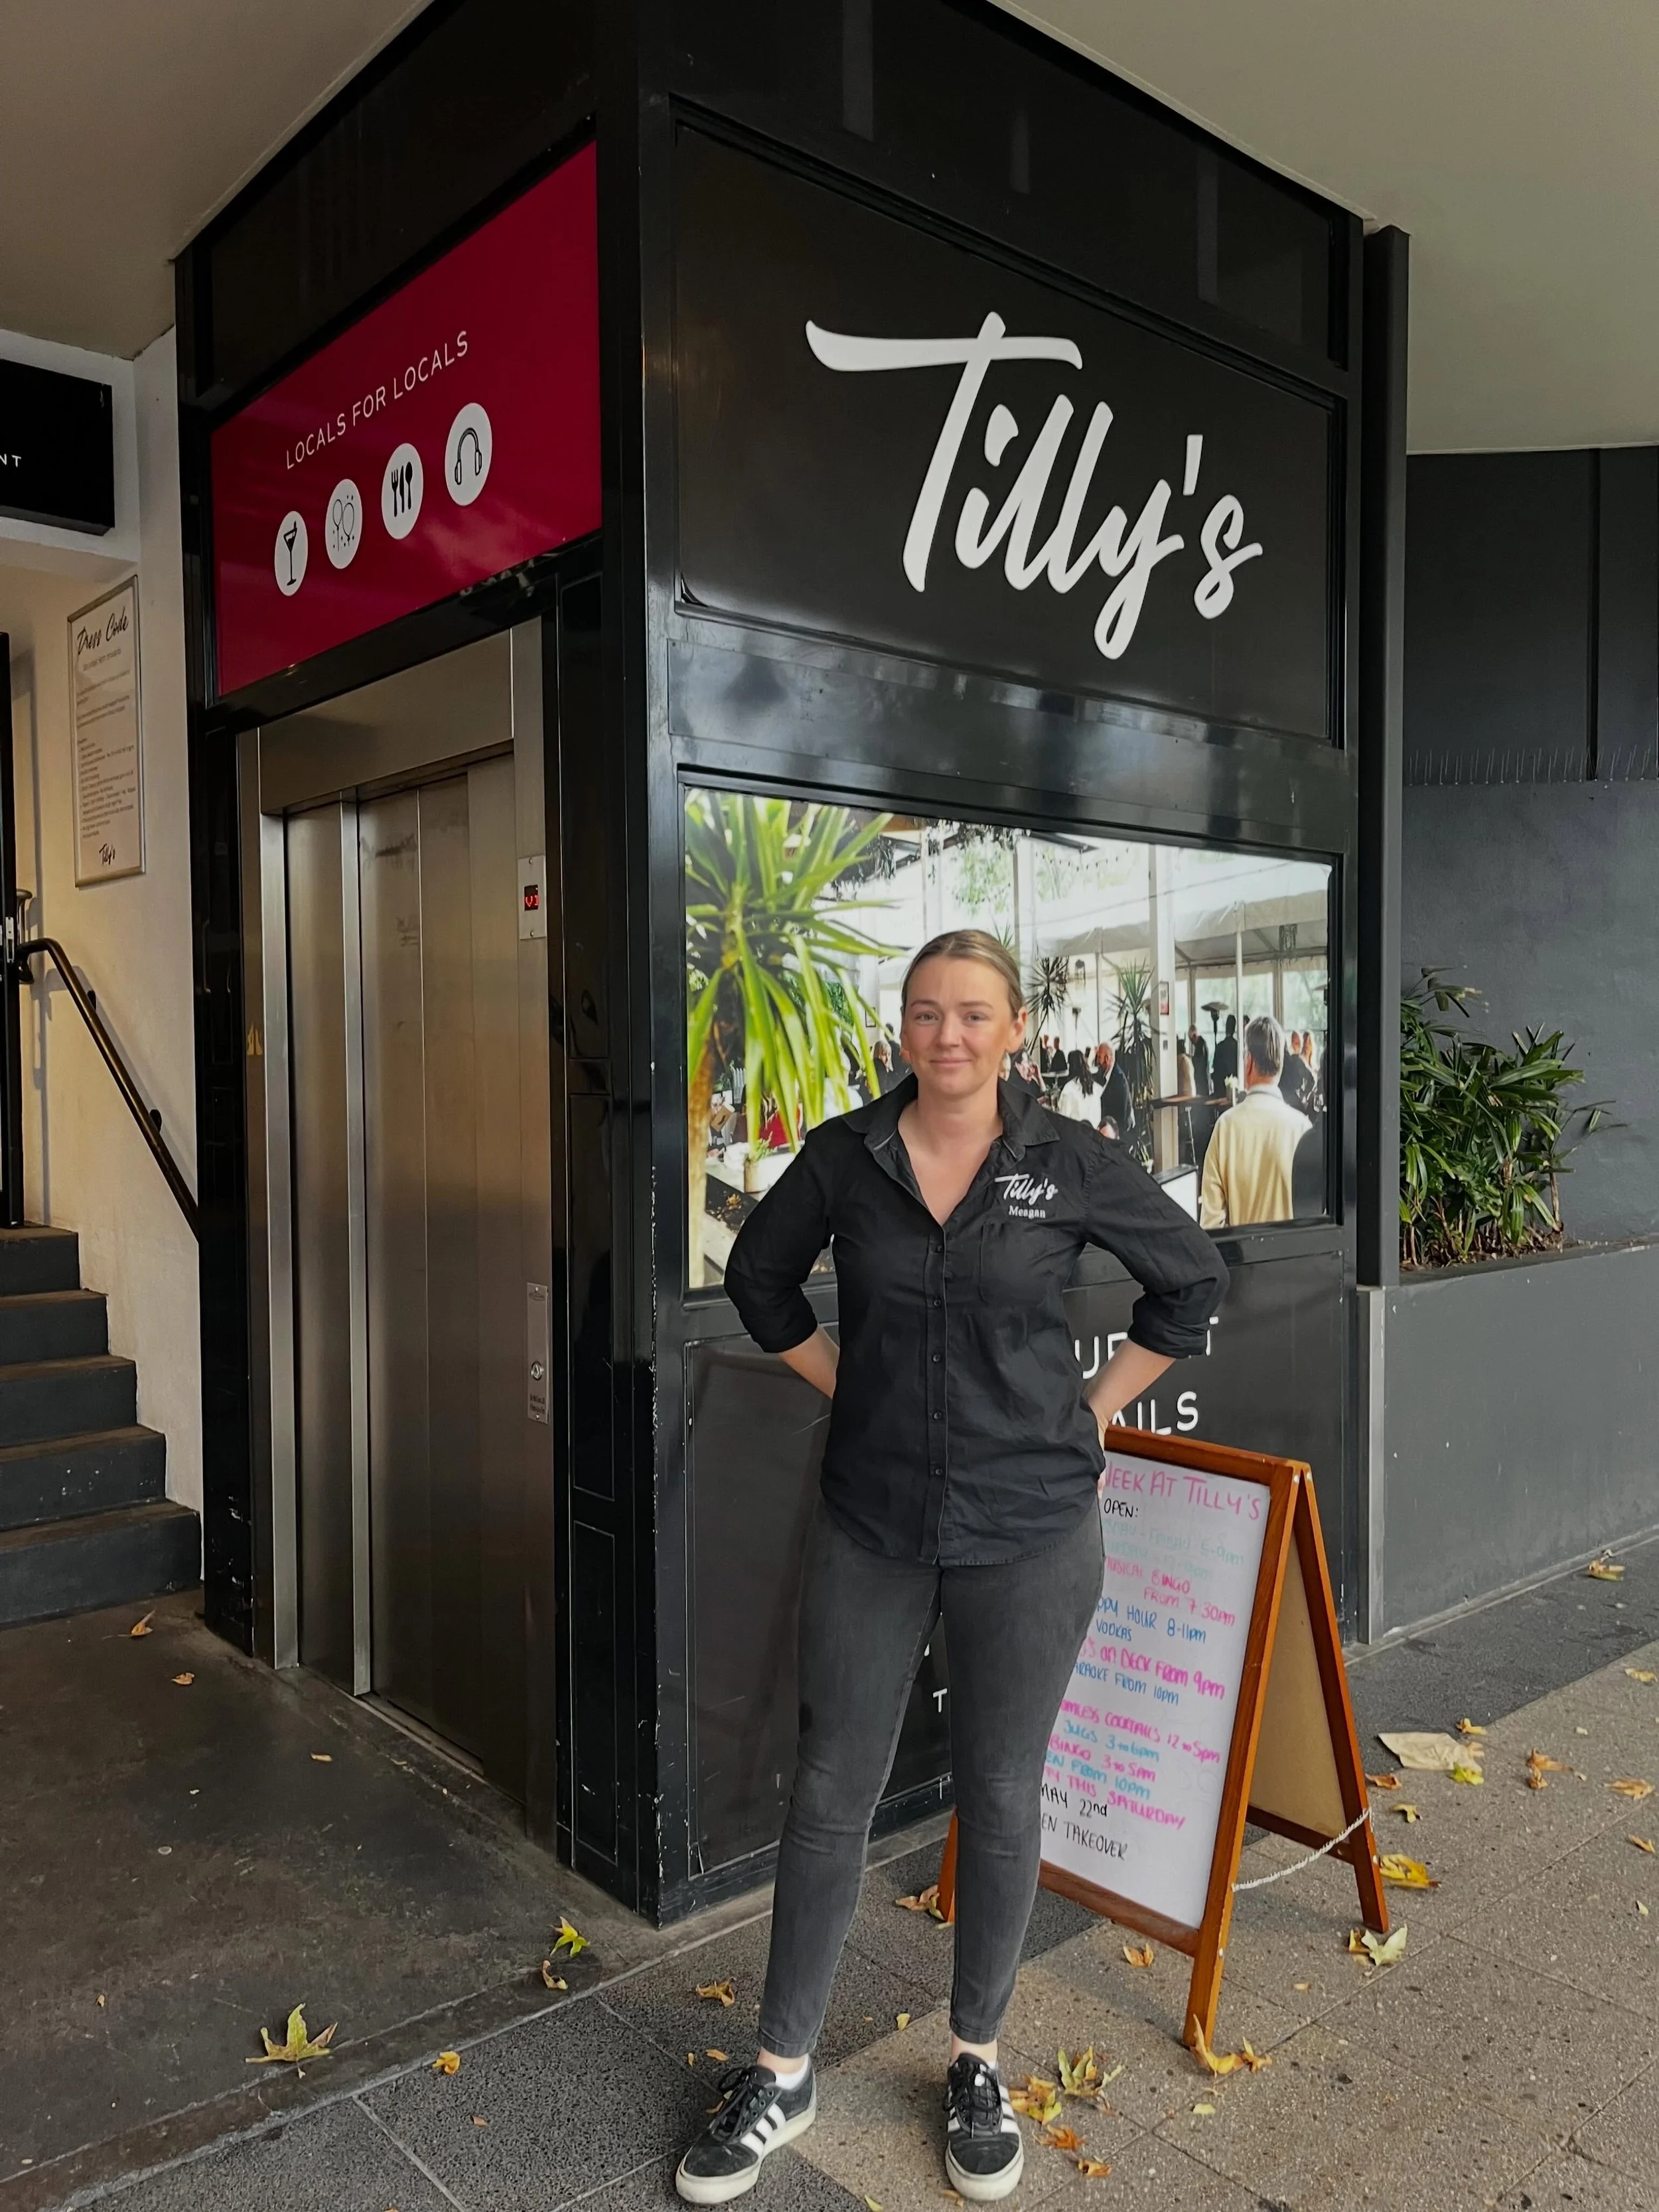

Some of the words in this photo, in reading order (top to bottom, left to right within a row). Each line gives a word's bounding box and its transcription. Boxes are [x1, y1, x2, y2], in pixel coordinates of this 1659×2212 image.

[286, 413, 347, 470] LOCALS
[352, 386, 387, 427] FOR
[393, 331, 469, 400] LOCALS
[805, 311, 1263, 660] Tilly's
[77, 627, 102, 656] Dress
[106, 606, 129, 642] Code
[995, 1173, 1058, 1206] Tilly's
[1009, 1205, 1046, 1219] Meagan
[1104, 1498, 1139, 1518] OPEN:
[1149, 1470, 1179, 1497] AT
[1183, 1476, 1261, 1520] TILLY'S
[1151, 1568, 1190, 1594] BINGO
[1096, 1619, 1133, 1642] VODKAS
[1127, 1604, 1158, 1630] HOUR
[1115, 1672, 1147, 1695] FROM
[1120, 1647, 1152, 1673] DECK
[1193, 1670, 1226, 1700] 9pm
[1063, 1719, 1098, 1744] JUGS
[1106, 1733, 1116, 1750] 3
[1166, 1733, 1180, 1749] 12
[1049, 1734, 1092, 1761] BINGO
[1101, 1753, 1112, 1770] 3
[1066, 1773, 1098, 1799] THIS
[1106, 1789, 1187, 1831] SATURDAY
[1079, 1798, 1108, 1819] 22nd
[1063, 1820, 1128, 1861] TAKEOVER
